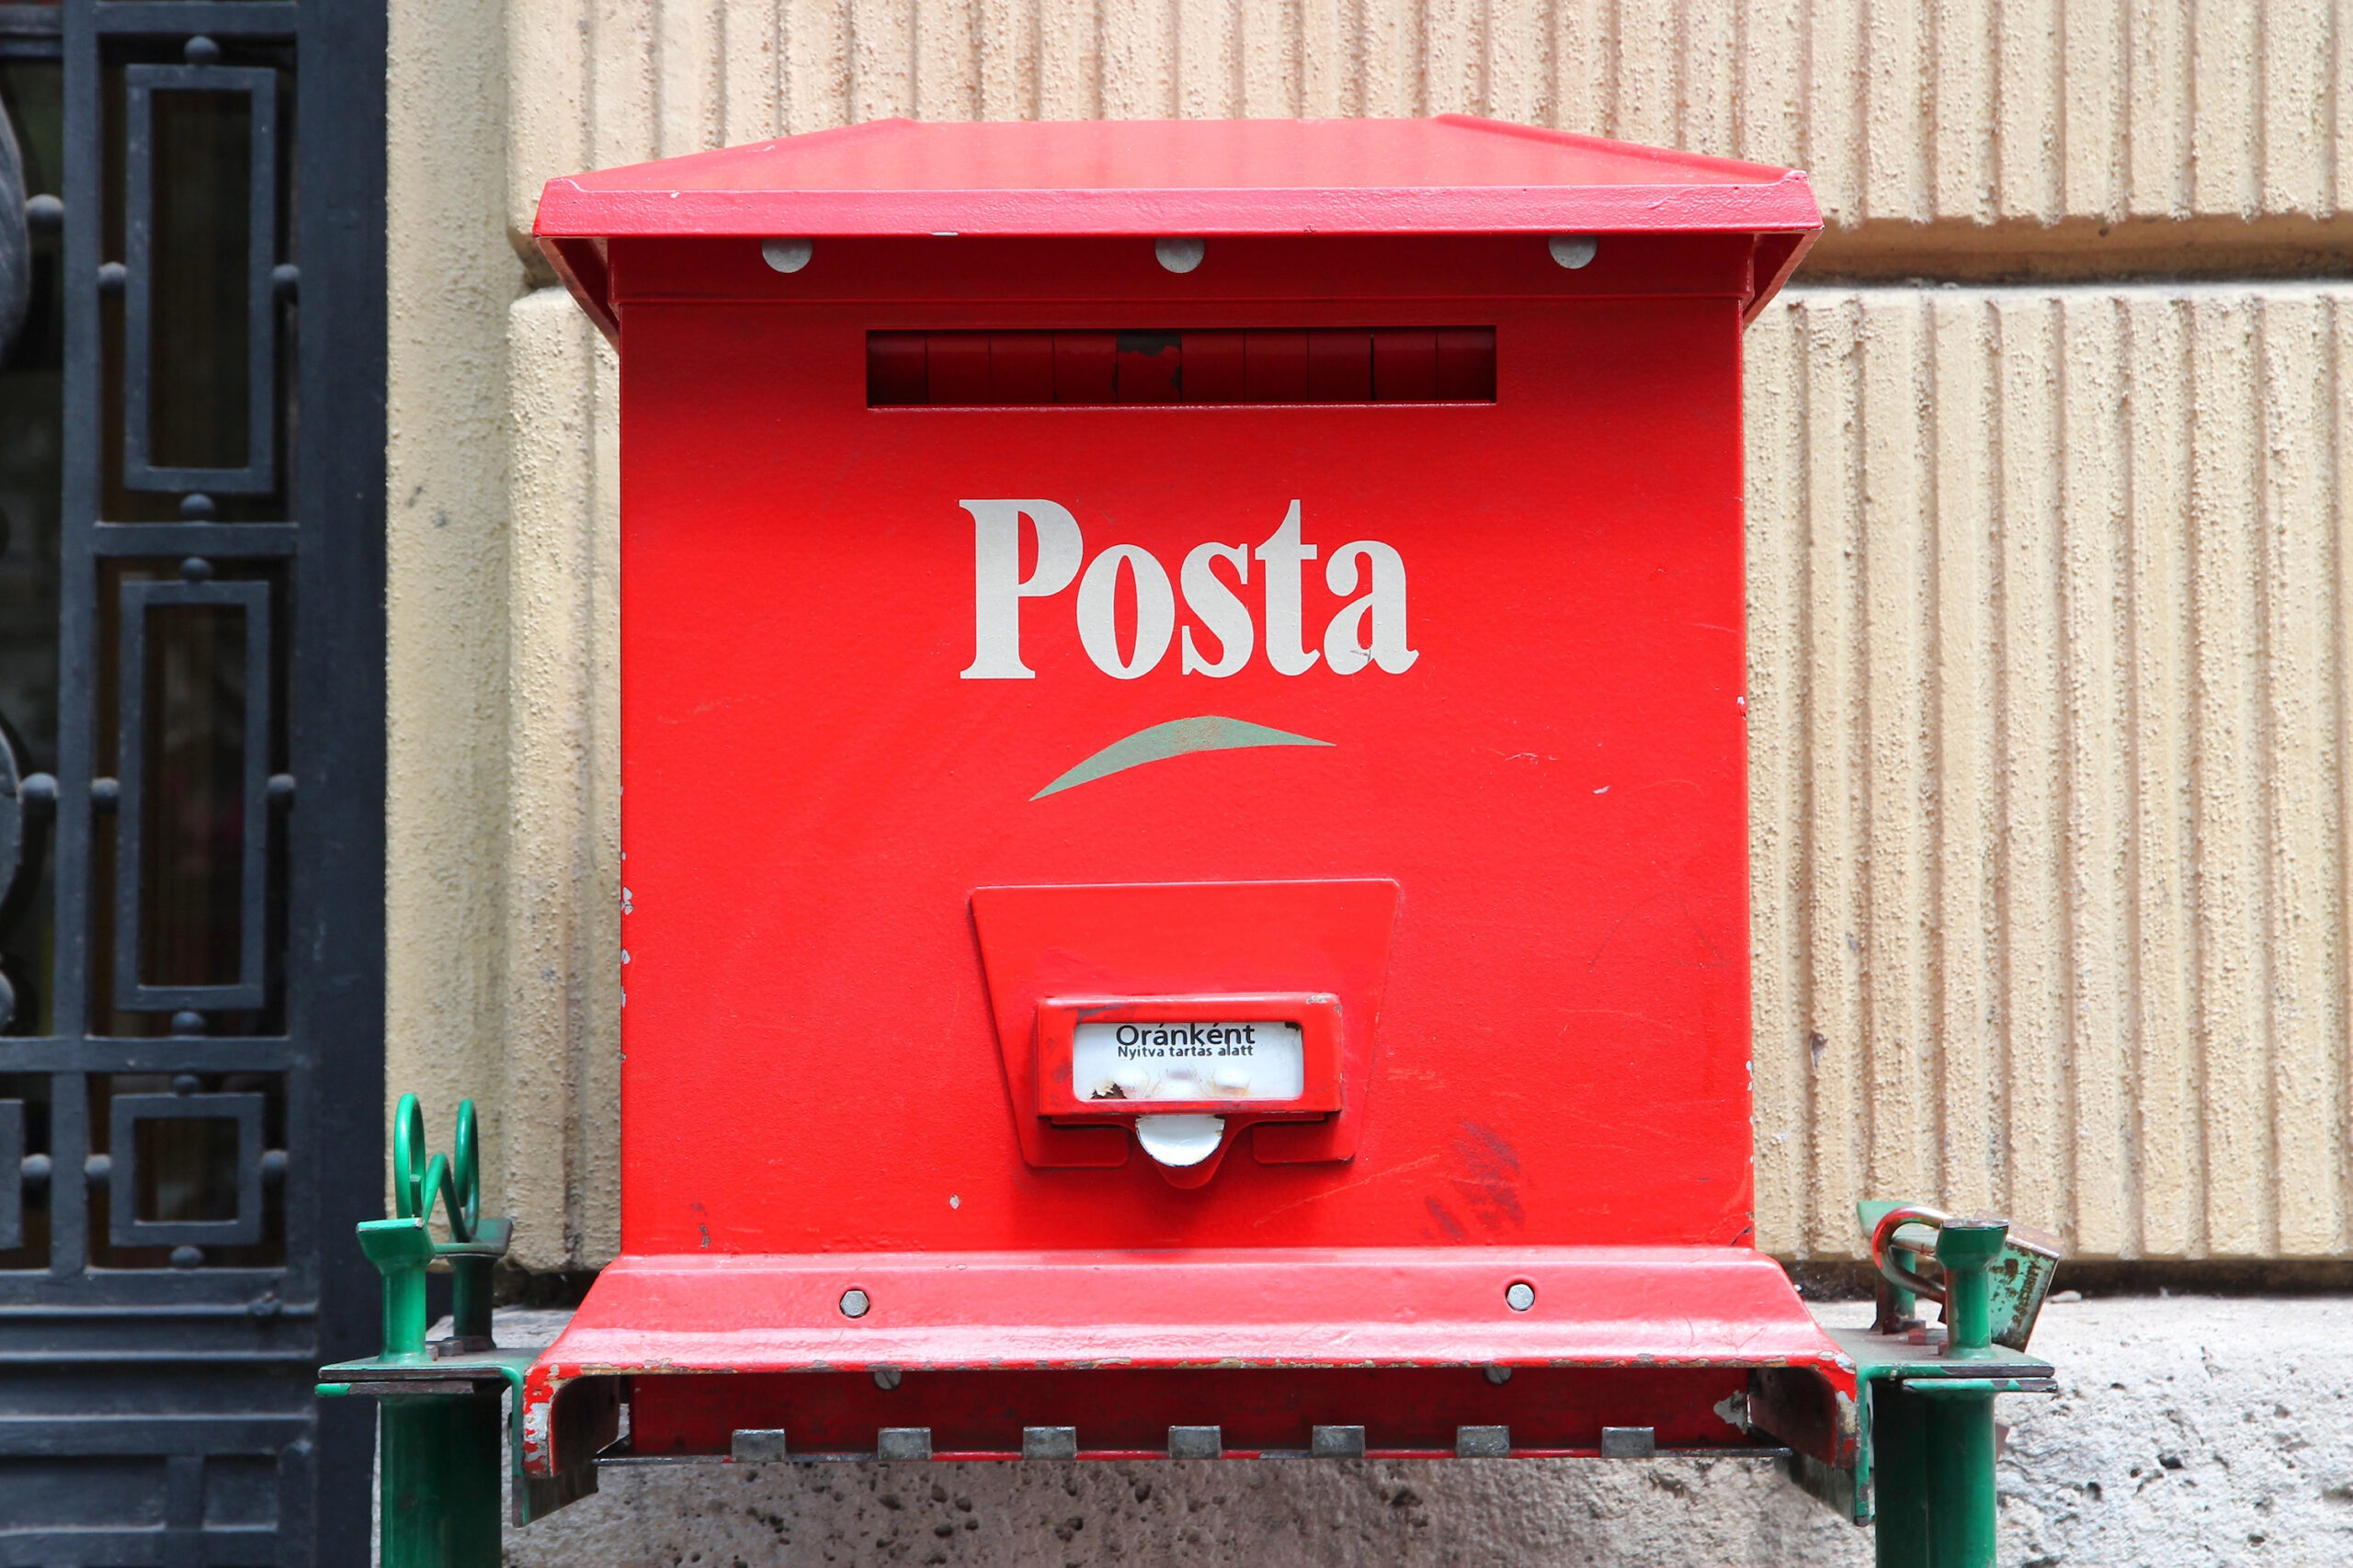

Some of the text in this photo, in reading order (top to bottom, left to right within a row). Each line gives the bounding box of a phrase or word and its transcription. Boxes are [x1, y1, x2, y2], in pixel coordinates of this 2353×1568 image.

[959, 499, 1420, 680] Posta
[1118, 1045, 1165, 1061] Nyitva
[1218, 1043, 1254, 1056] alatt
